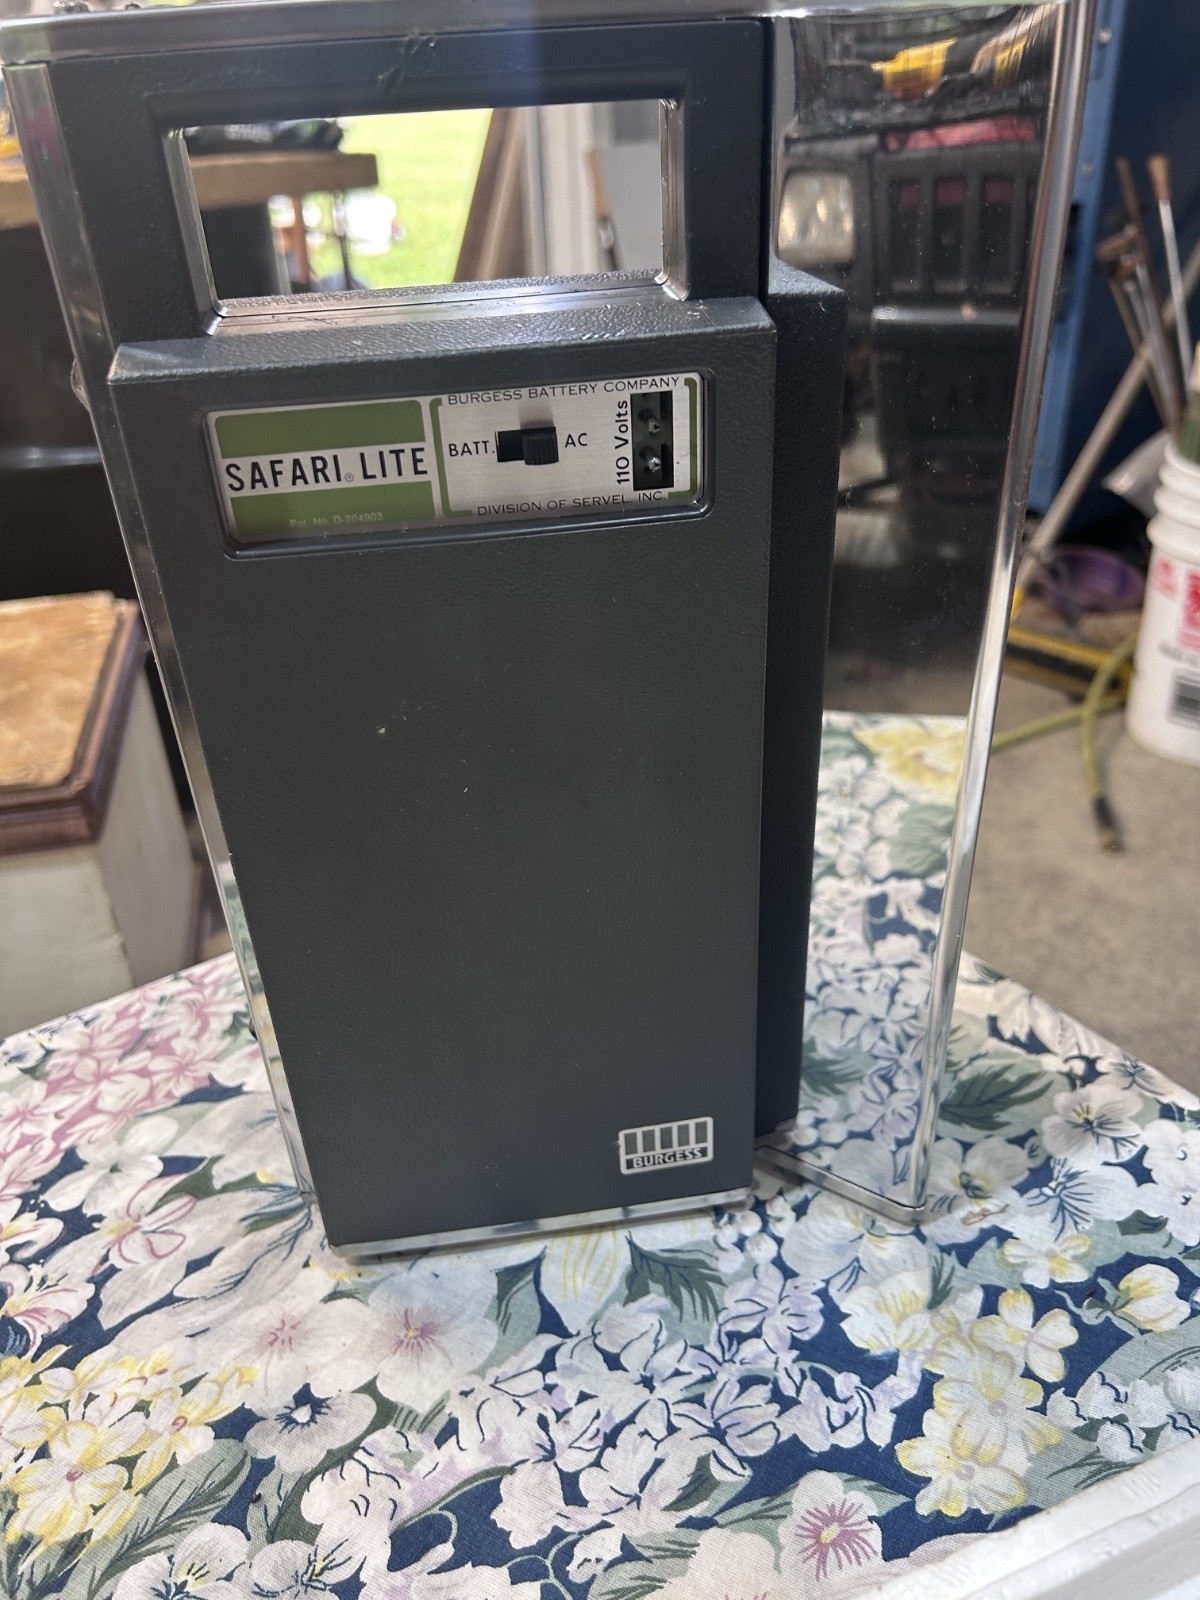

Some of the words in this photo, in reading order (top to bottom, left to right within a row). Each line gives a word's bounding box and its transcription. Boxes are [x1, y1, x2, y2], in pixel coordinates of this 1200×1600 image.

[448, 391, 523, 405] BURGESS
[529, 383, 597, 398] BATTERY
[604, 376, 680, 392] COMPANY
[615, 400, 628, 449] Volts
[449, 441, 495, 457] BATT.
[565, 433, 587, 448] AC
[360, 447, 427, 479] LITE
[616, 457, 630, 484] 110
[477, 502, 541, 516] DIVISION
[547, 500, 567, 510] OF
[638, 491, 666, 501] INC.
[634, 1148, 702, 1167] BURGESS
